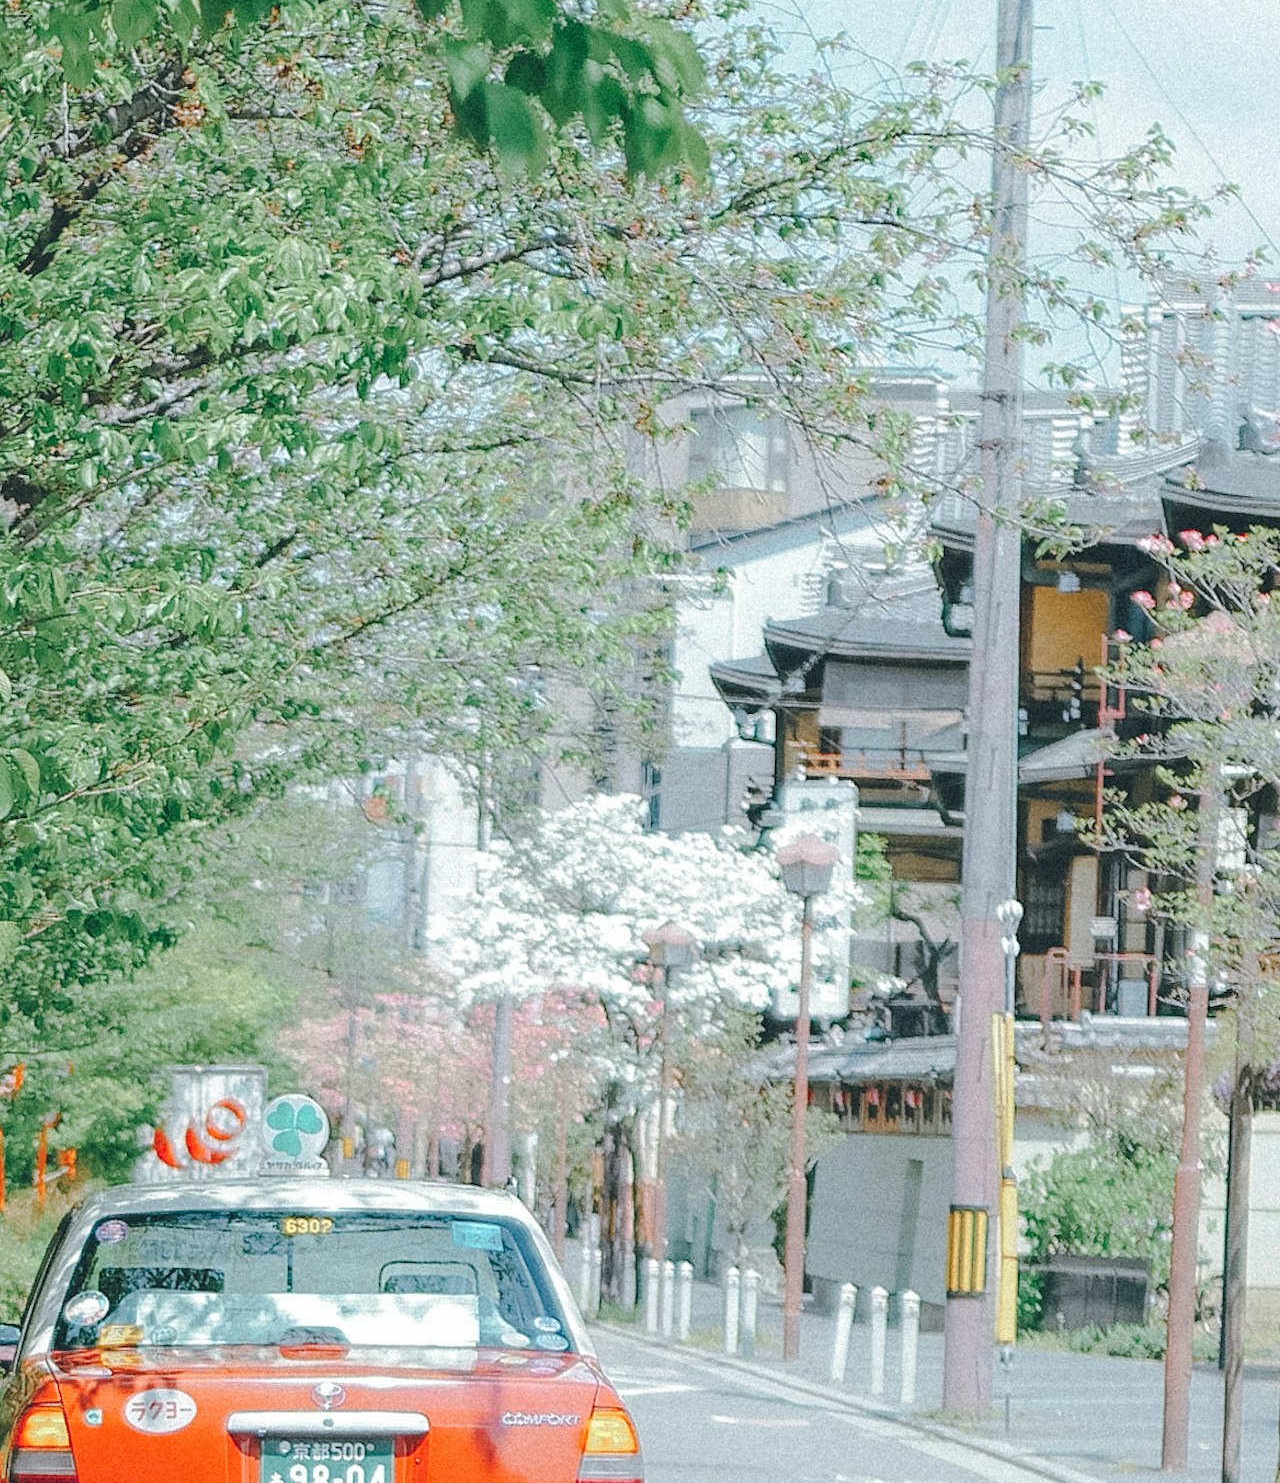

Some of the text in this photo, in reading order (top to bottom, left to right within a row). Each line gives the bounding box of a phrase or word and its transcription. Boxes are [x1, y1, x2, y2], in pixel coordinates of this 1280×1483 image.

[130, 1400, 193, 1422] ラクヨー
[501, 1410, 582, 1427] COMFORT
